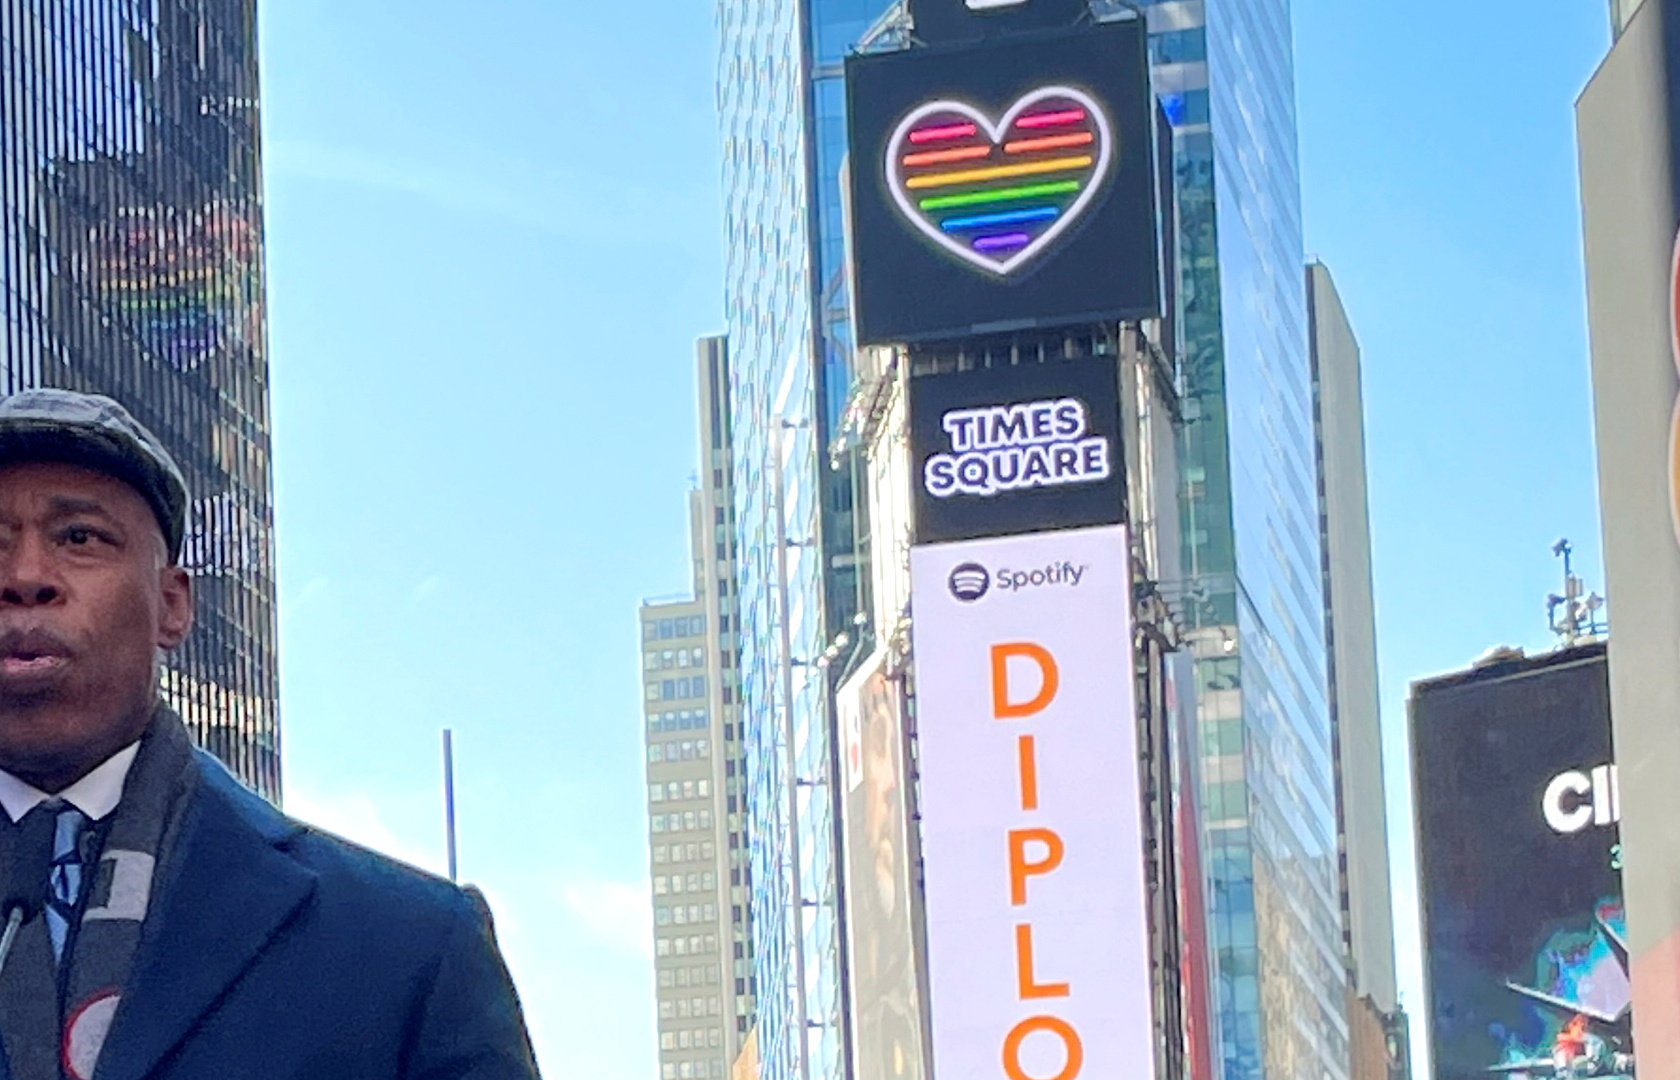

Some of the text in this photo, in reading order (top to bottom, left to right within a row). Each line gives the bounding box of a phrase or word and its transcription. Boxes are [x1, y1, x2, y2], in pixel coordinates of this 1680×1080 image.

[947, 404, 1082, 449] TIMES
[928, 441, 1105, 492] SQUARE
[996, 562, 1084, 593] Spotify
